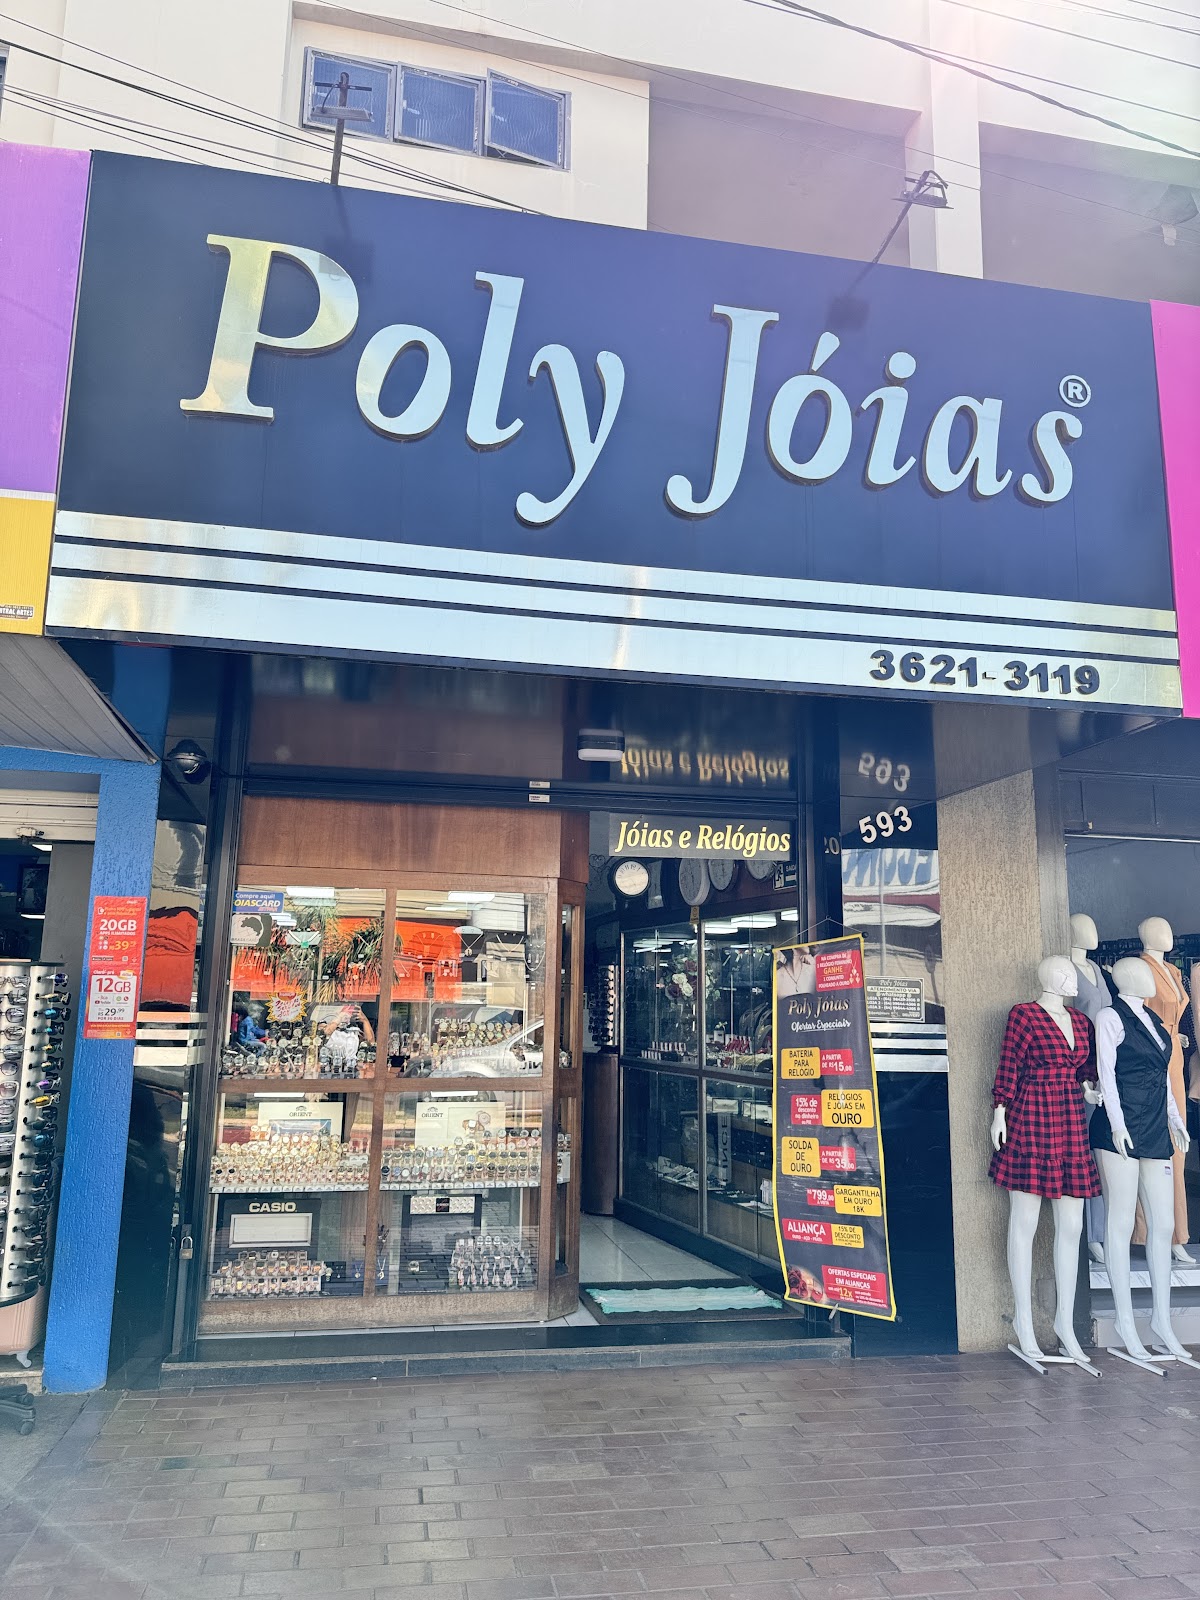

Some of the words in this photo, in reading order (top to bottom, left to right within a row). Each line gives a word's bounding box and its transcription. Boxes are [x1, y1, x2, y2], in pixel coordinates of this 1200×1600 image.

[178, 233, 626, 527] Poly
[665, 303, 1083, 516] Jóias
[869, 649, 1101, 695] 3621-3119
[858, 805, 913, 844] 593
[615, 821, 673, 853] Jóias
[679, 829, 692, 847] e
[696, 824, 791, 858] Relógios
[100, 919, 137, 931] 20GB
[823, 965, 843, 975] GANHE
[95, 977, 131, 992] 12GB
[788, 998, 813, 1019] Poly
[814, 996, 850, 1019] Jóias
[791, 1021, 816, 1032] Ofertas
[817, 1018, 851, 1032] Especiais
[789, 1050, 813, 1058] BATERIA
[794, 1059, 809, 1067] PARA
[809, 1098, 818, 1107] de
[855, 1102, 865, 1110] EM
[831, 1112, 862, 1124] OURO
[788, 1140, 812, 1150] SOLDA
[795, 1151, 806, 1161] DE
[790, 1163, 812, 1173] OURO
[835, 1187, 880, 1197] GARGANTILHA
[248, 1202, 297, 1213] CASIO
[787, 1221, 826, 1237] ALIANÇA
[834, 1232, 861, 1240] DESCONTO
[828, 1268, 850, 1277] OFERTAS
[850, 1271, 877, 1281] ESPECIAIS
[845, 1279, 871, 1289] ALIANÇAS
[839, 1288, 853, 1298] 12x
